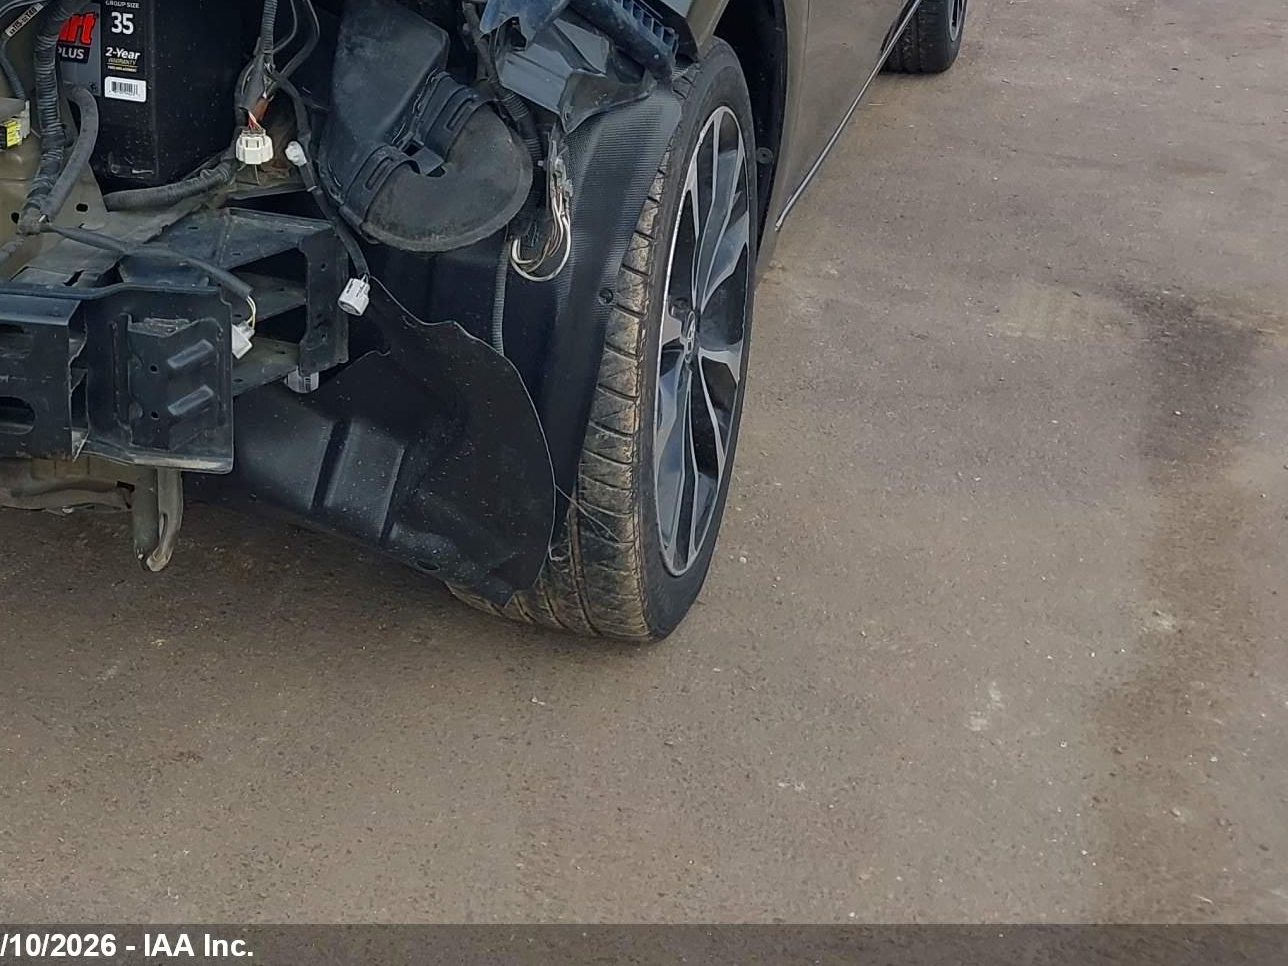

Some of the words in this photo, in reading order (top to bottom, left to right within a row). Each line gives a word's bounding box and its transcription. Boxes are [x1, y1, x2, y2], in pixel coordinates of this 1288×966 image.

[105, 0, 127, 8] GROUP
[126, 1, 140, 9] SIZE
[111, 11, 135, 35] 35
[105, 46, 141, 60] 2-Year
